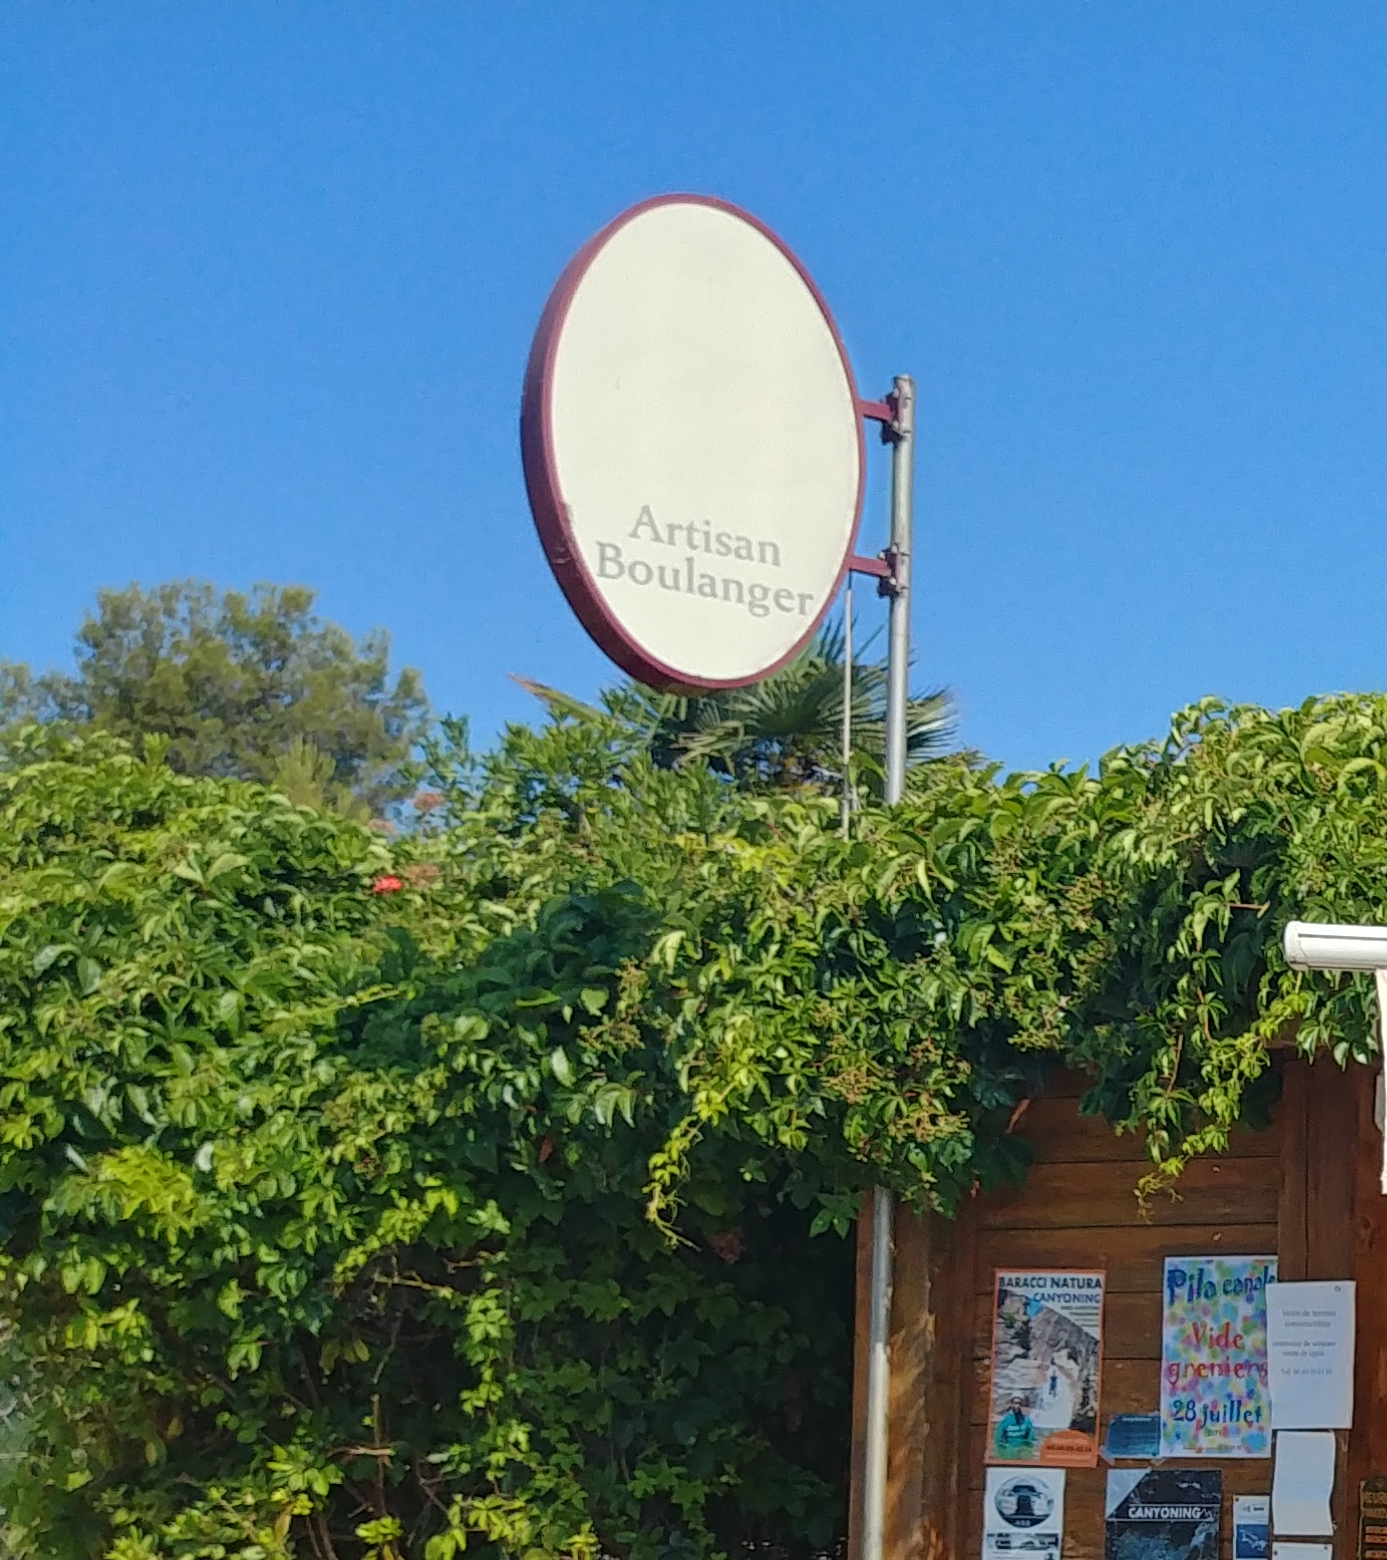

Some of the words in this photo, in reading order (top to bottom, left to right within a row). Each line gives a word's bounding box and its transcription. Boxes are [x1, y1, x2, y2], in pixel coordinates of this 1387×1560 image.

[628, 504, 782, 567] Artisan
[596, 541, 815, 617] Boulanger
[1191, 1321, 1245, 1351] Vide
[1172, 1399, 1197, 1422] 28
[1200, 1399, 1263, 1429] juillet
[1128, 1506, 1201, 1519] CANYONING
